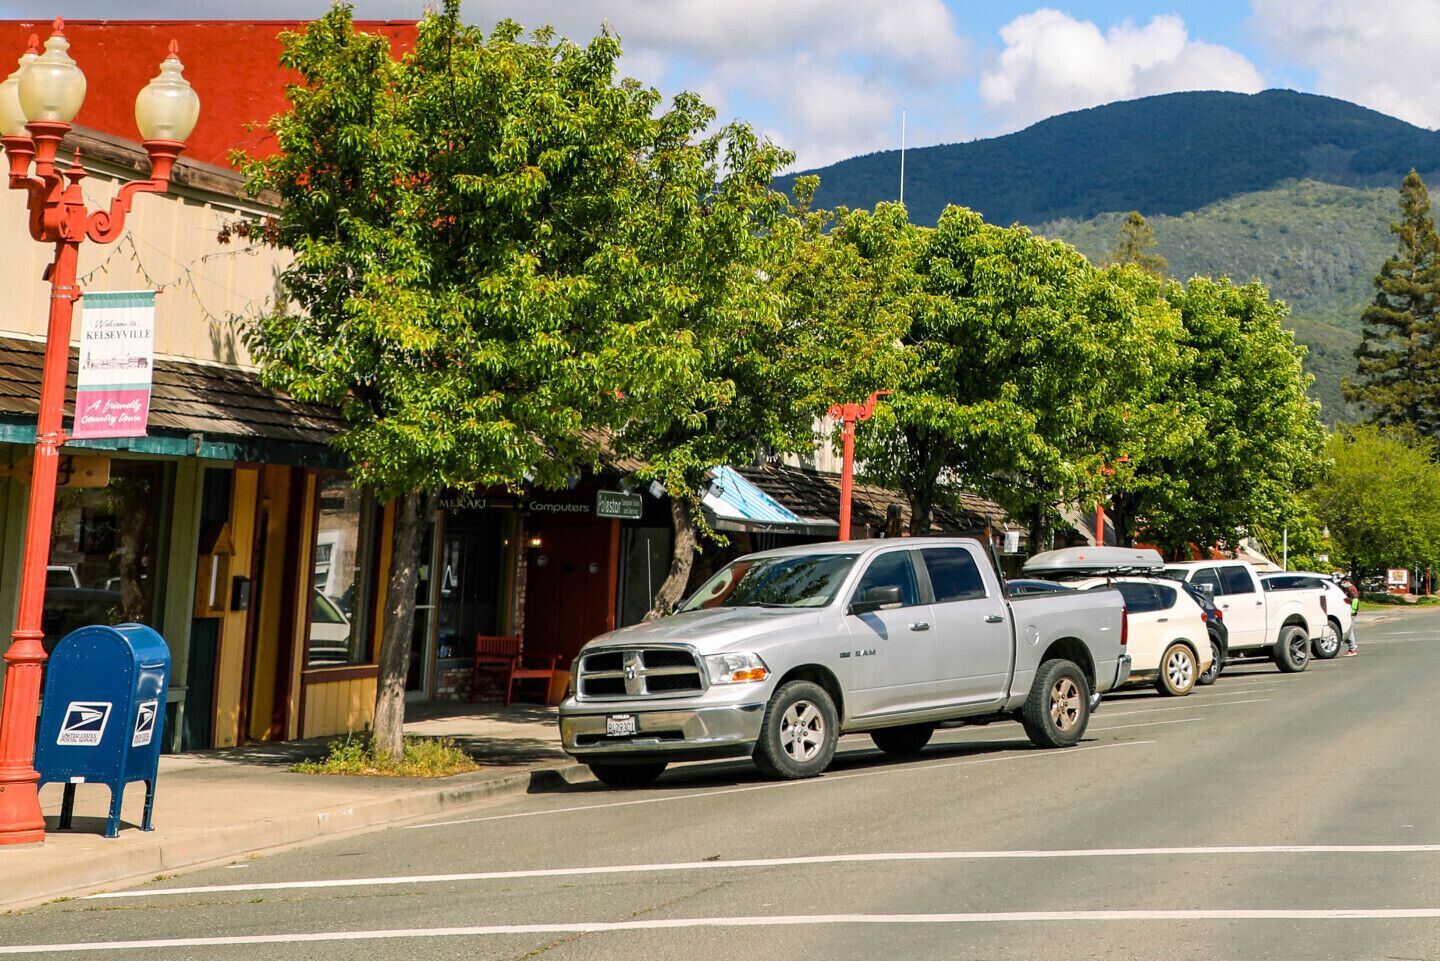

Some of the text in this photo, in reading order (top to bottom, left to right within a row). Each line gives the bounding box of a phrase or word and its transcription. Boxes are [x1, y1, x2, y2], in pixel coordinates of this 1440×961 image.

[95, 320, 127, 328] Welcome
[86, 330, 151, 340] KELSEYVILLE
[86, 398, 142, 413] A friendly
[81, 412, 142, 426] country town
[529, 501, 590, 513] Computers
